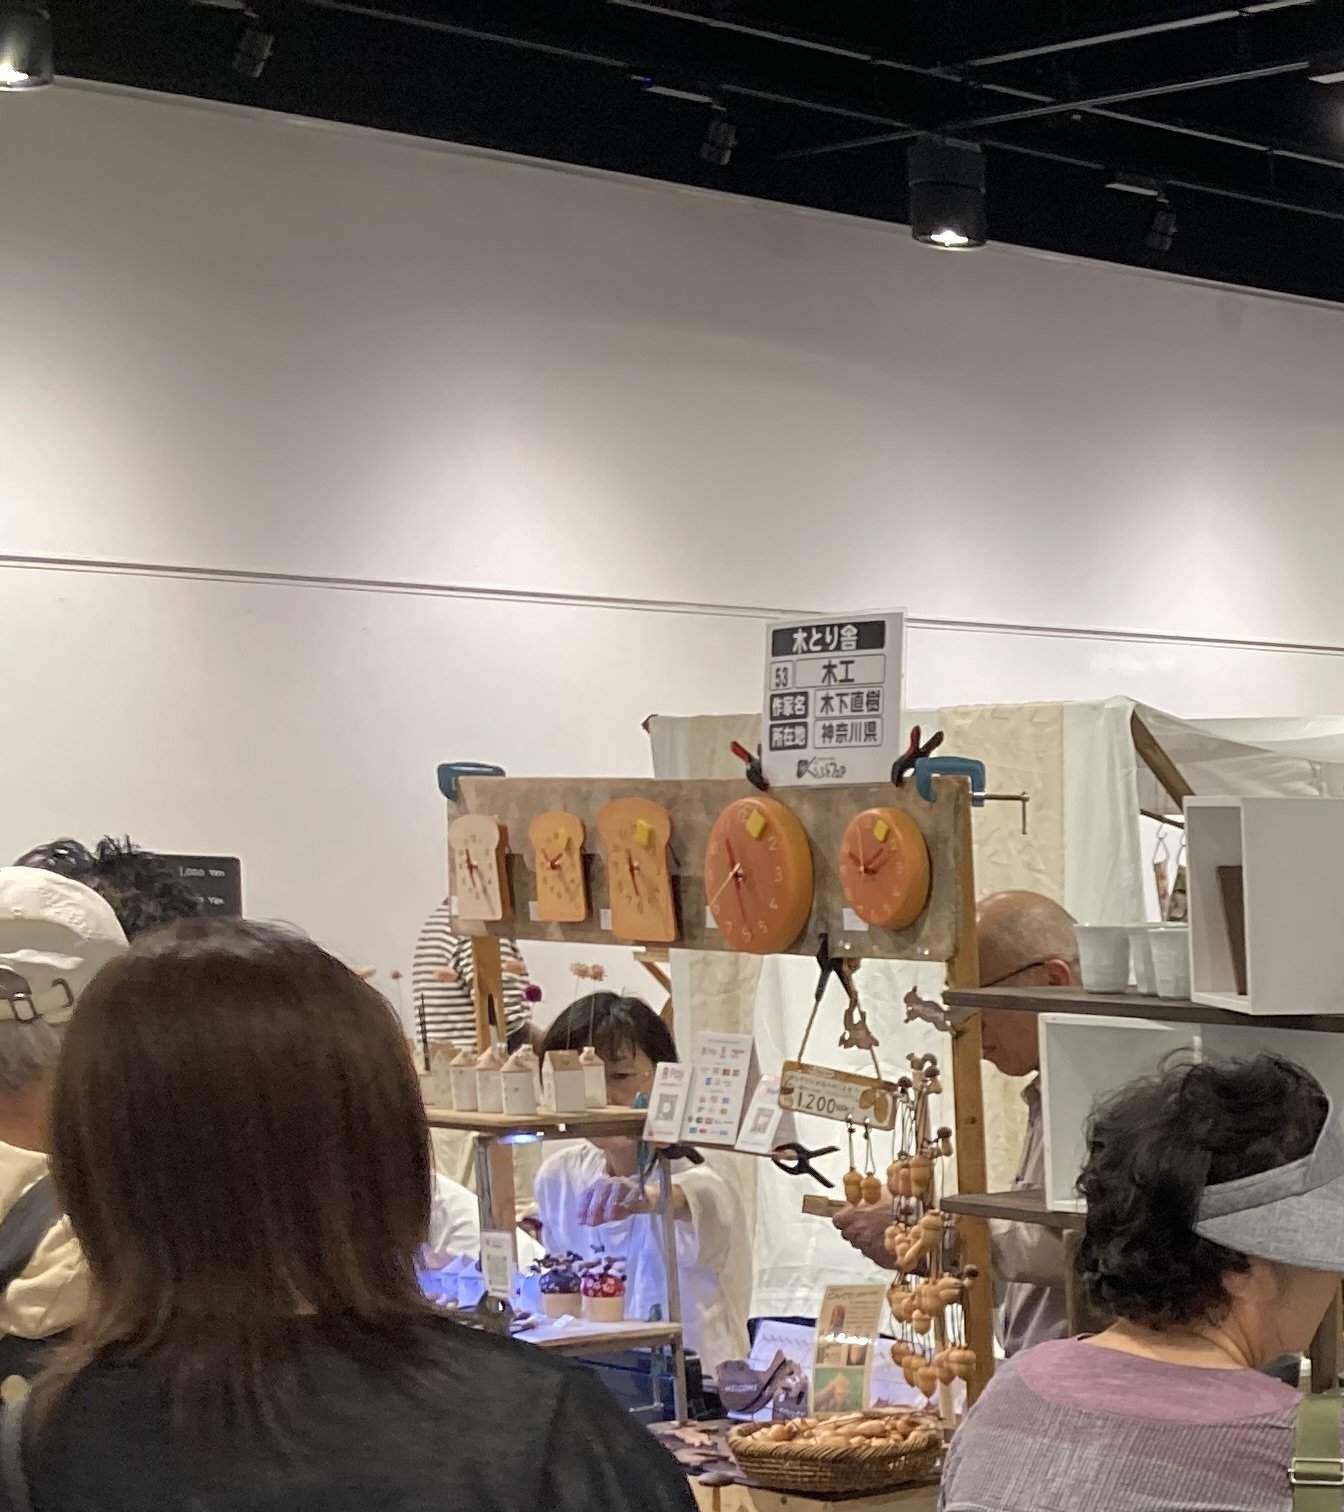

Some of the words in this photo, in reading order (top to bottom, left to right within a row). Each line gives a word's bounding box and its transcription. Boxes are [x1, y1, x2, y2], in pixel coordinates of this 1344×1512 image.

[791, 624, 859, 654] 木とり舎
[774, 667, 788, 688] 53
[821, 659, 855, 687] 木工
[772, 695, 806, 718] 作家名
[772, 725, 806, 749] 所在地
[821, 721, 878, 745] 神奈川県
